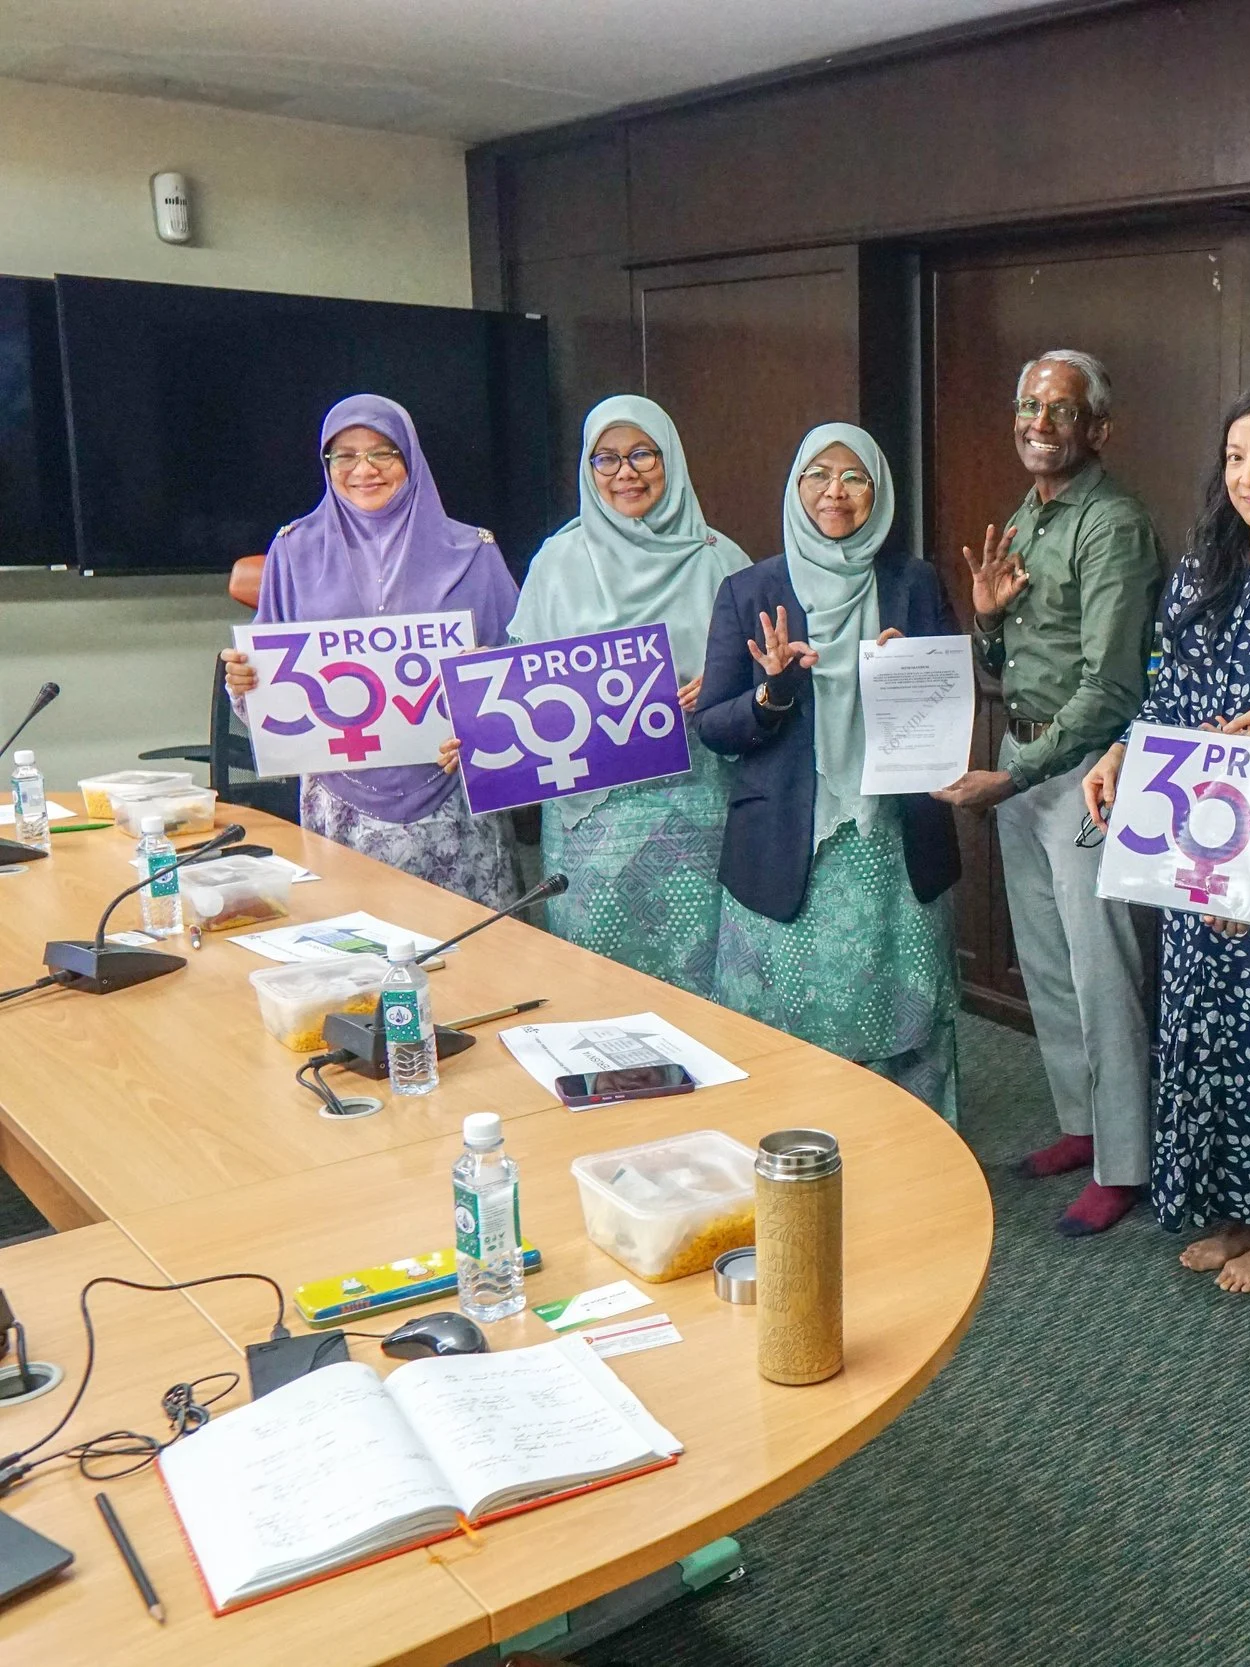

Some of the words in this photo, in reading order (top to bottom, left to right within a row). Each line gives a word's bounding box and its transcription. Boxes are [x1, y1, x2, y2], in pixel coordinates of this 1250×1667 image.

[319, 621, 464, 657] PROJEK
[521, 633, 663, 682] PROJEK
[456, 657, 675, 790] 30%
